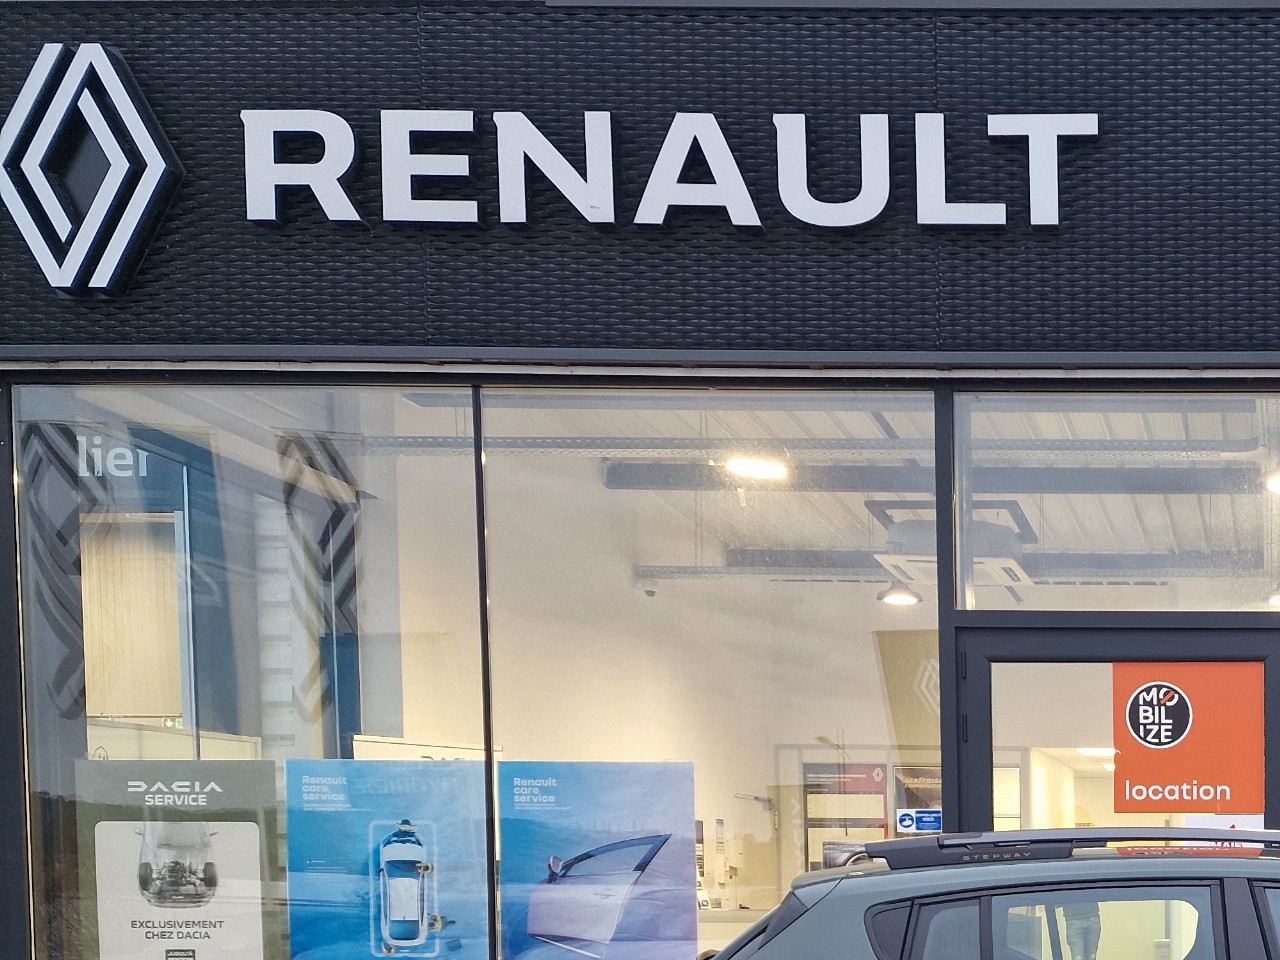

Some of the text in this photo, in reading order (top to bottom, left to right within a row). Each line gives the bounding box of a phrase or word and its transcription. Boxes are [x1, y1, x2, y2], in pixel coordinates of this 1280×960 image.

[240, 109, 1099, 227] RENAULT
[302, 775, 347, 785] Renault
[513, 777, 557, 787] Renault
[127, 780, 223, 793] DACIA
[302, 785, 328, 793] care
[1125, 780, 1231, 800] location
[145, 794, 207, 806] SERVICE
[302, 793, 346, 801] service
[513, 794, 556, 803] service
[962, 852, 1032, 861] STEPWAY
[131, 920, 224, 929] EXCLUSIVEMENT
[145, 931, 210, 940] CHEZ DACIA
